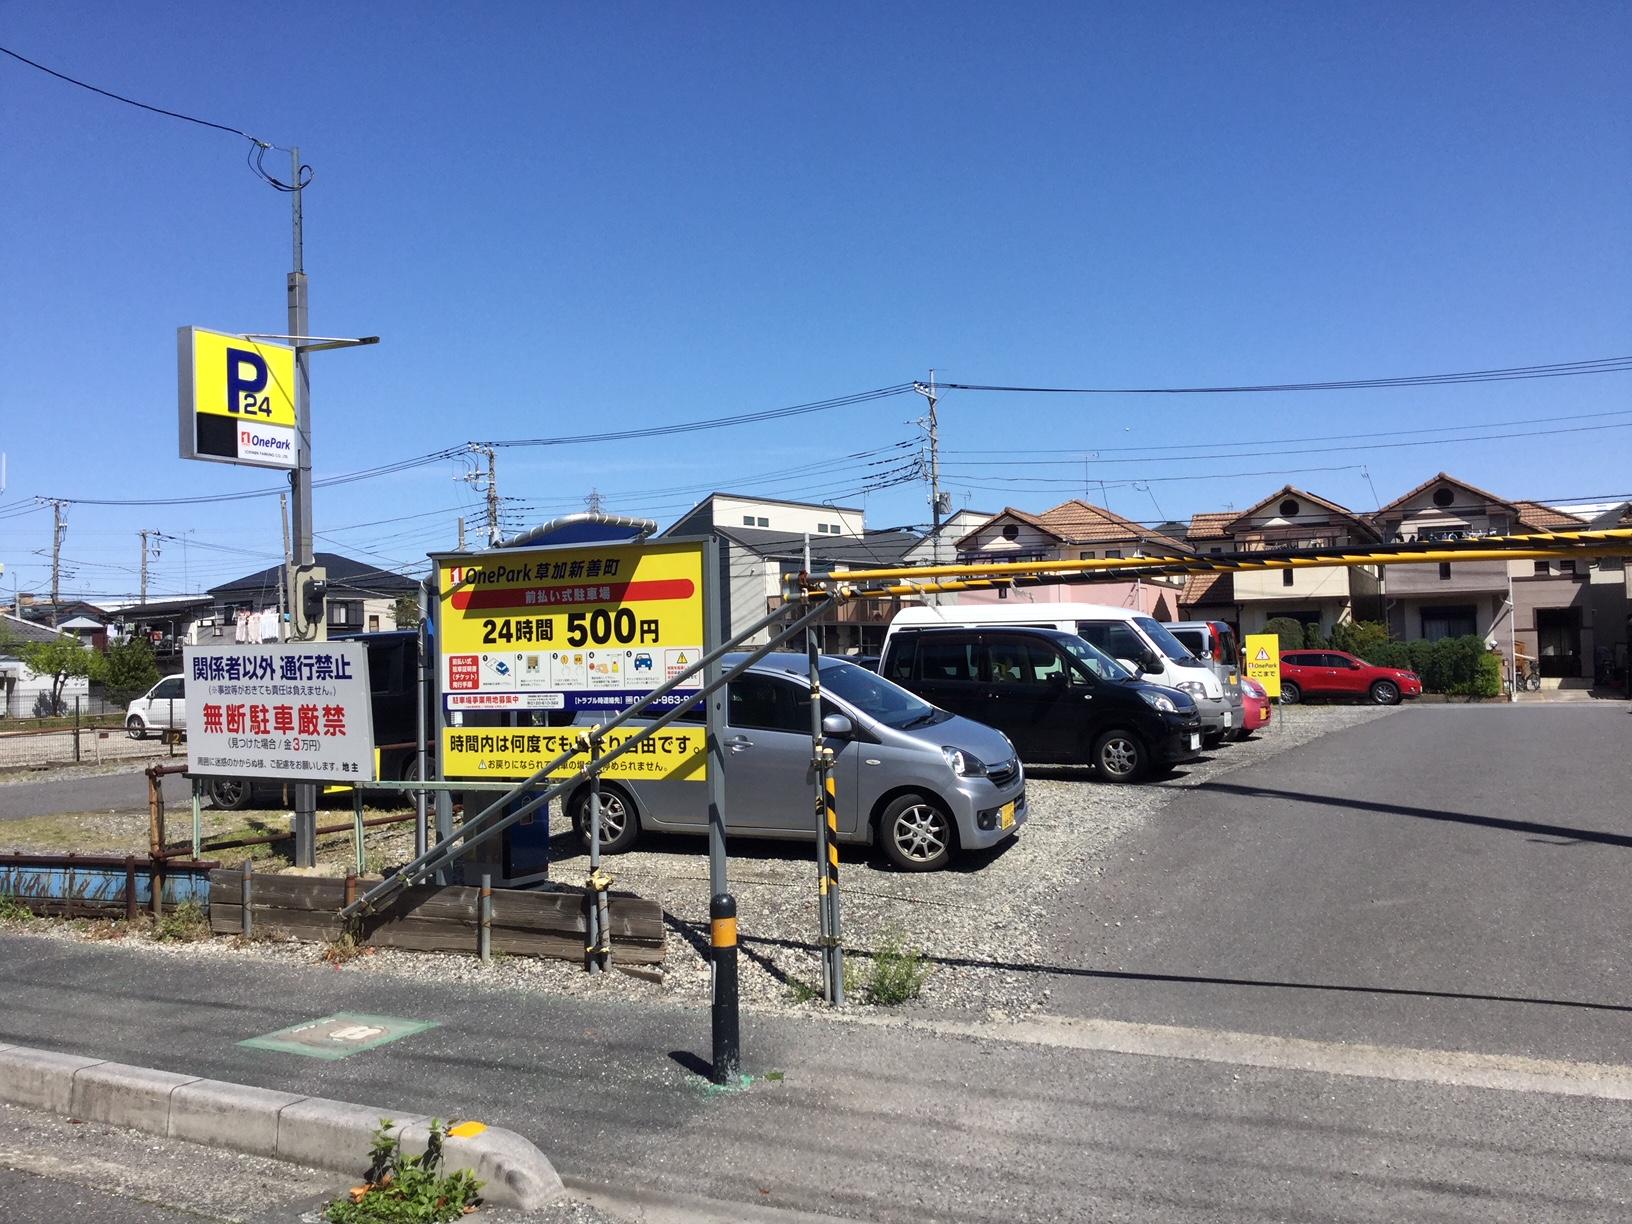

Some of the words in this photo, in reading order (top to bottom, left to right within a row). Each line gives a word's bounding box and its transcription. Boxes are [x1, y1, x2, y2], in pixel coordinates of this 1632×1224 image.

[227, 347, 268, 413] P
[244, 394, 272, 417] 24
[252, 435, 290, 450] OnePark
[465, 562, 532, 584] OnePark
[535, 558, 620, 580] 草加新善町
[525, 586, 610, 604] 前払い式駐車場
[483, 618, 553, 644] 24時間
[567, 608, 660, 647] 500円
[193, 655, 275, 681] 関係者以外
[280, 654, 352, 681] 通行禁止
[203, 703, 347, 736] 無断駐車厳禁
[342, 762, 359, 772] 地主
